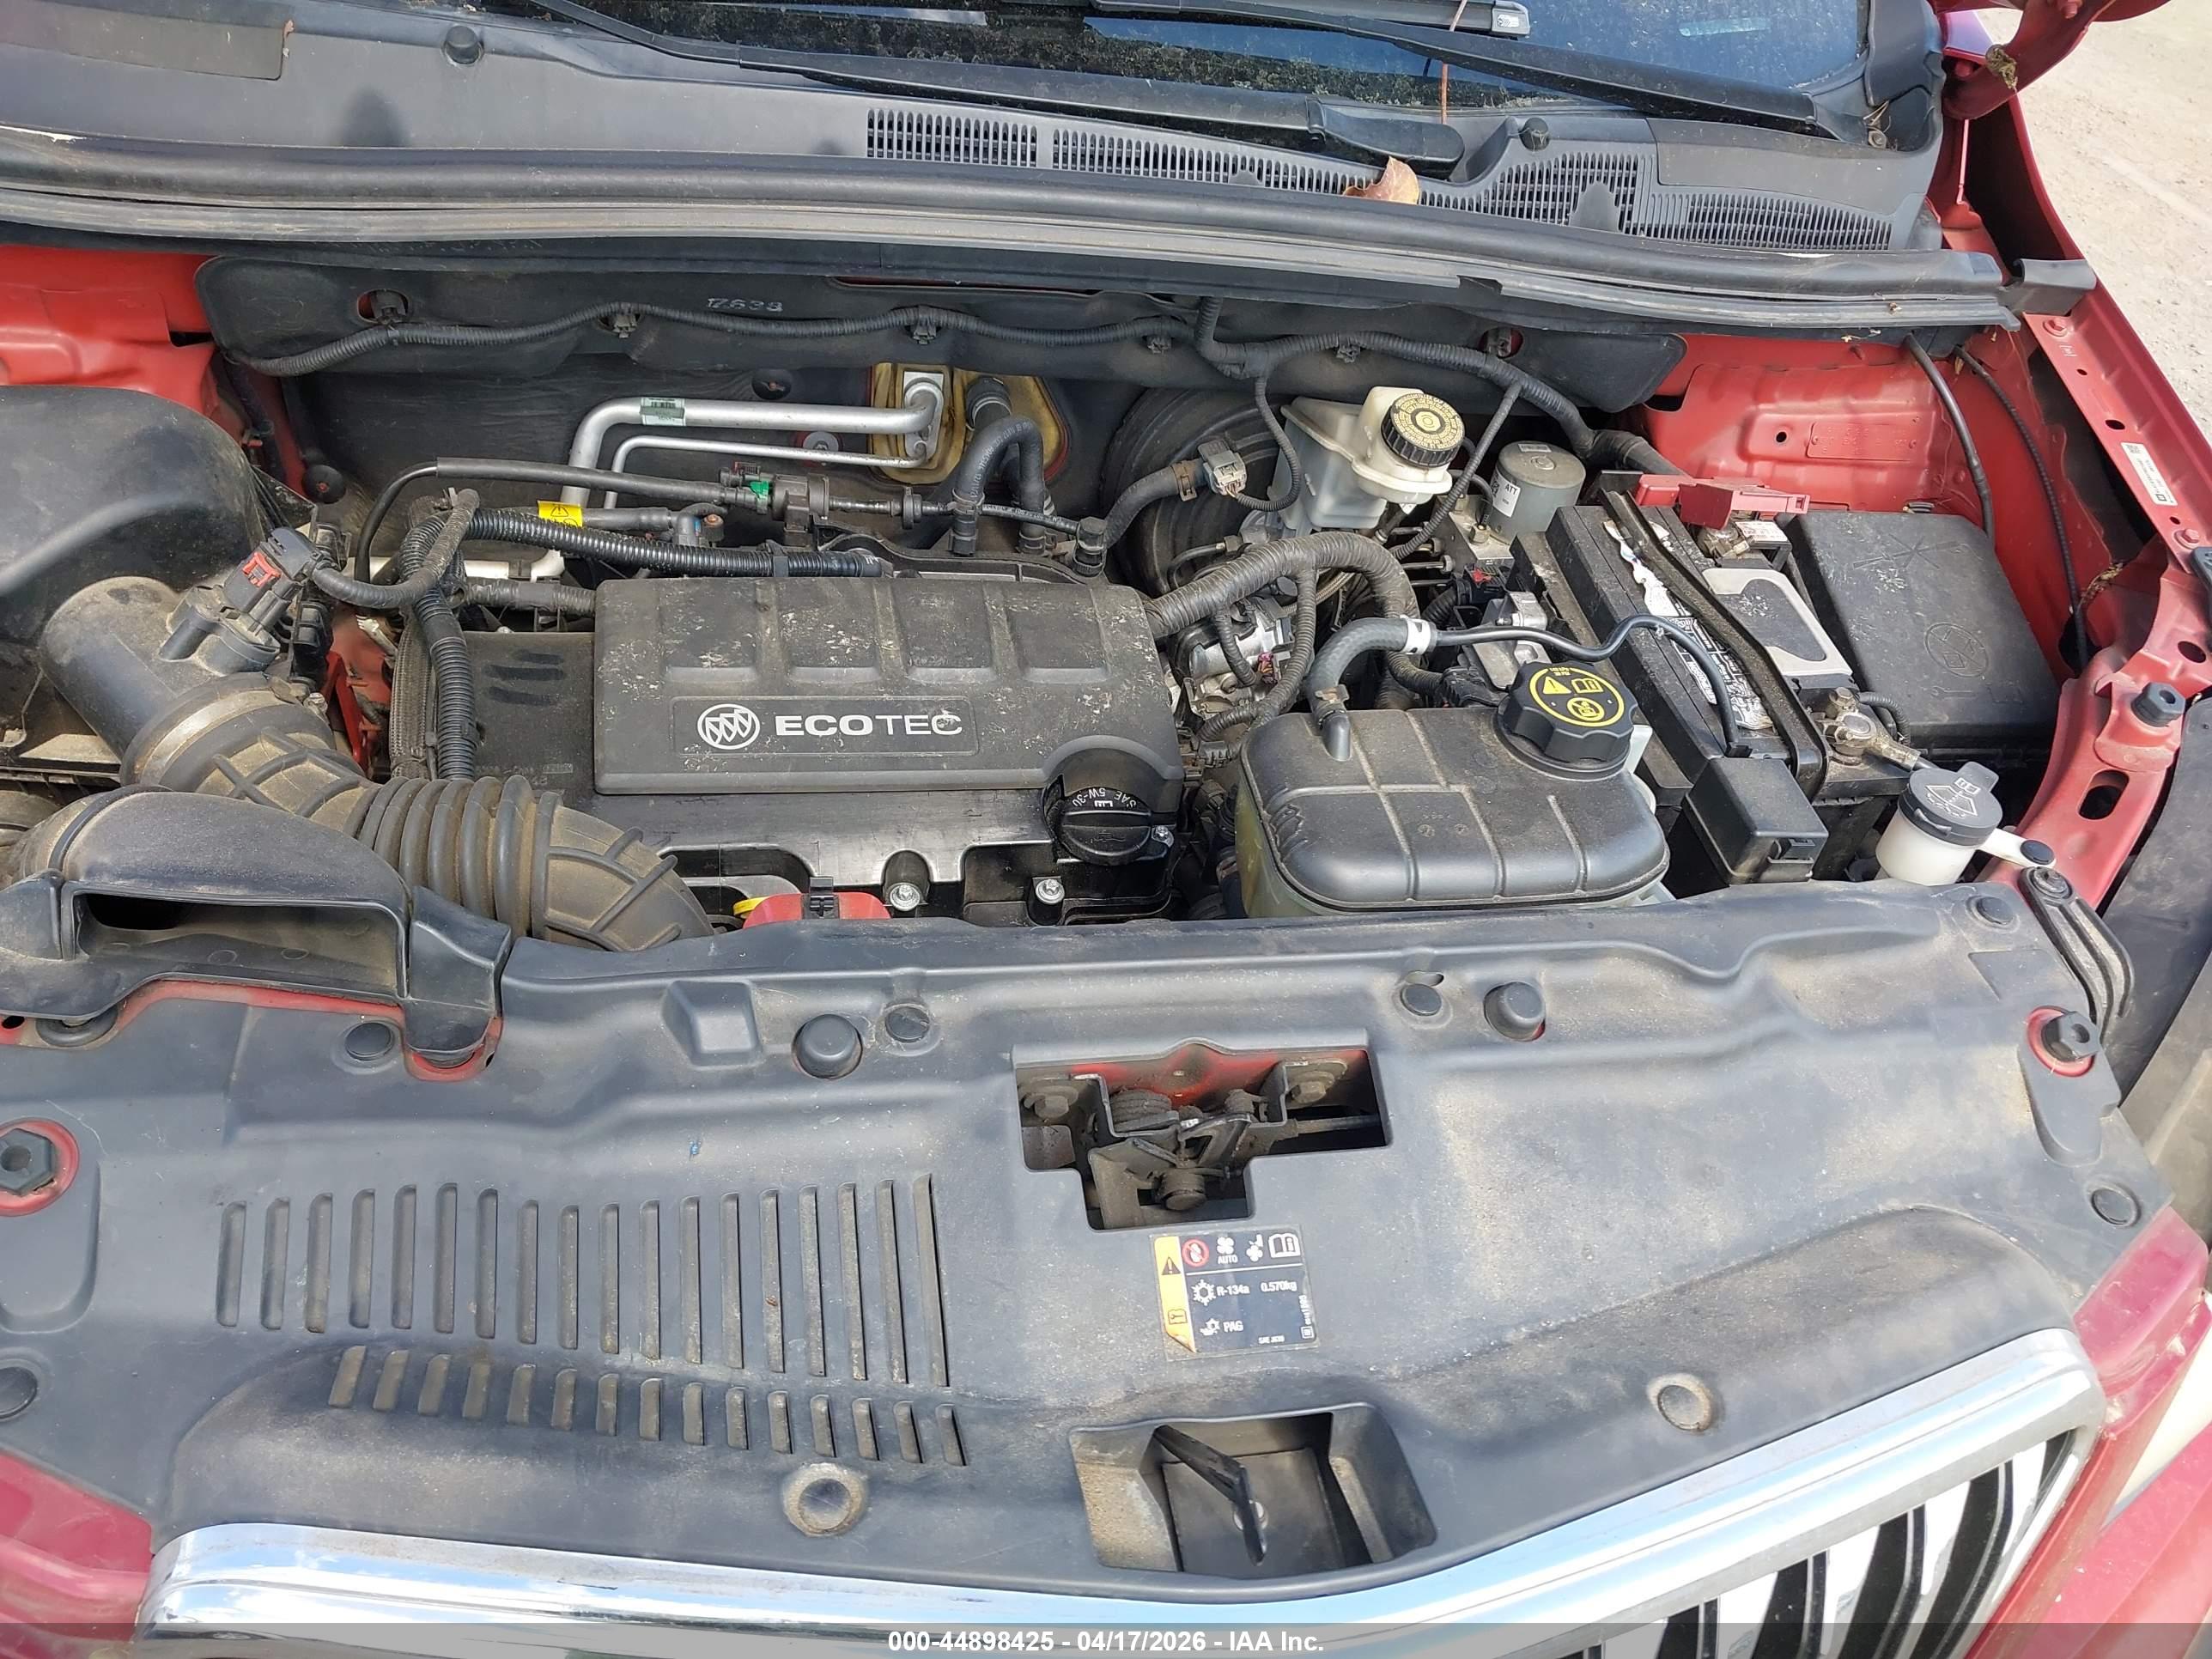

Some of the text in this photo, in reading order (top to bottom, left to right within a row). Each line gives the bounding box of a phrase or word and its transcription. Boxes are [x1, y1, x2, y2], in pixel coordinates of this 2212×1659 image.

[1504, 483, 1518, 495] ATT
[775, 715, 962, 736] ECOTEC
[1218, 1255, 1238, 1265] AUTO
[1217, 1280, 1297, 1297] R-134a 0.570kg
[1223, 1321, 1244, 1333] PAG
